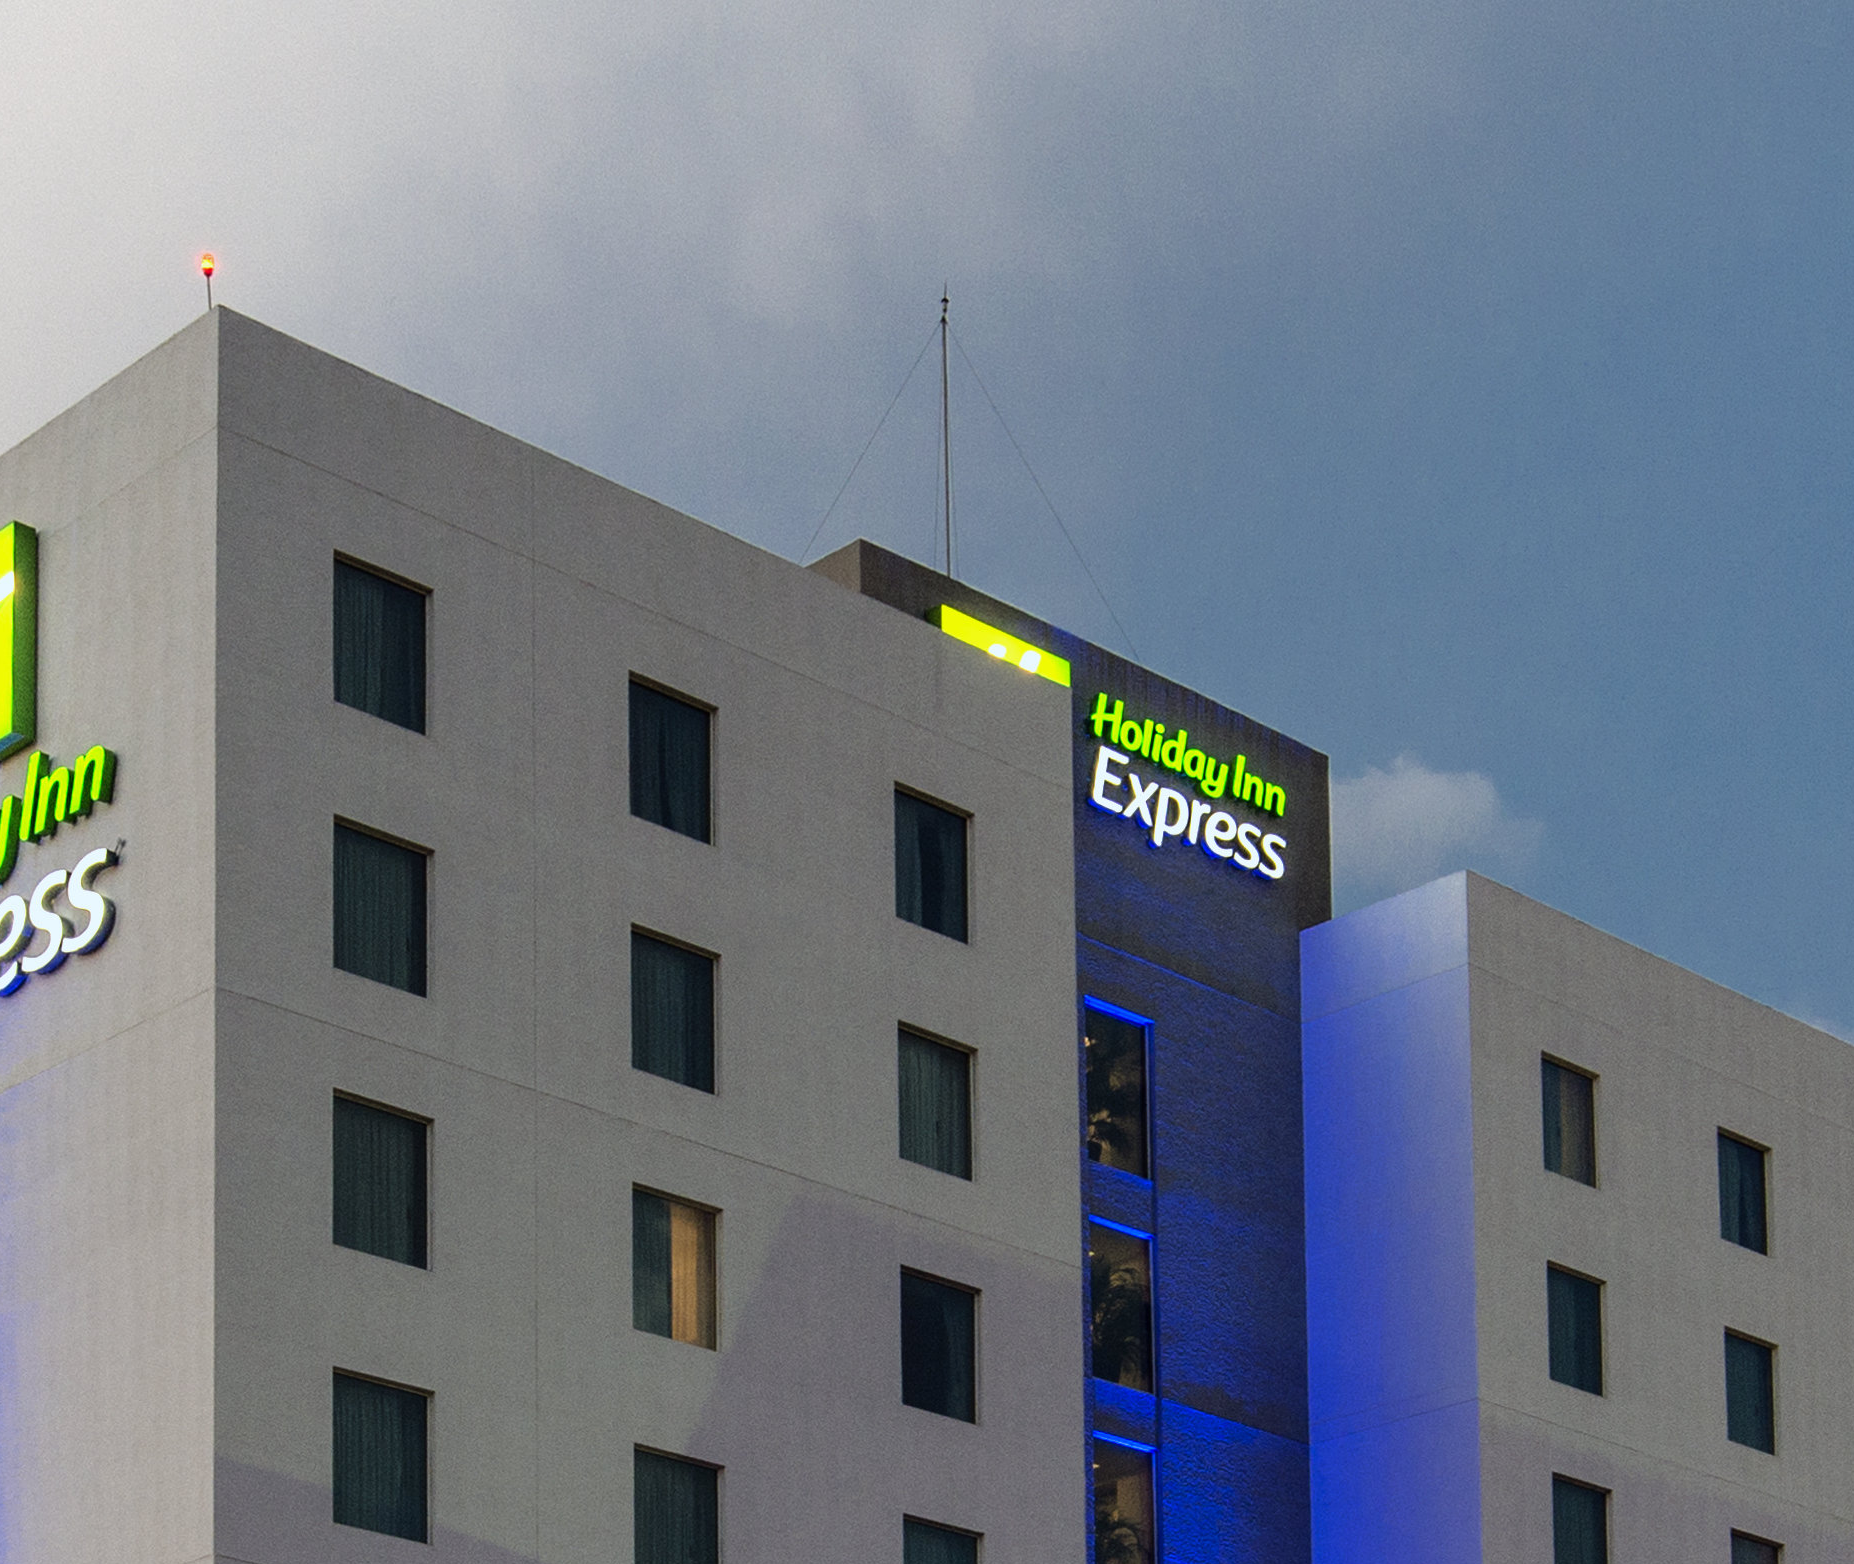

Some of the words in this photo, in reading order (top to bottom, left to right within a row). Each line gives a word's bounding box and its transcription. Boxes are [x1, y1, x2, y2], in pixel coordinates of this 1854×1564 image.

[19, 744, 109, 844] Inn
[1090, 691, 1229, 799] Holiday
[1233, 754, 1286, 817] Inn
[1090, 744, 1287, 881] Express
